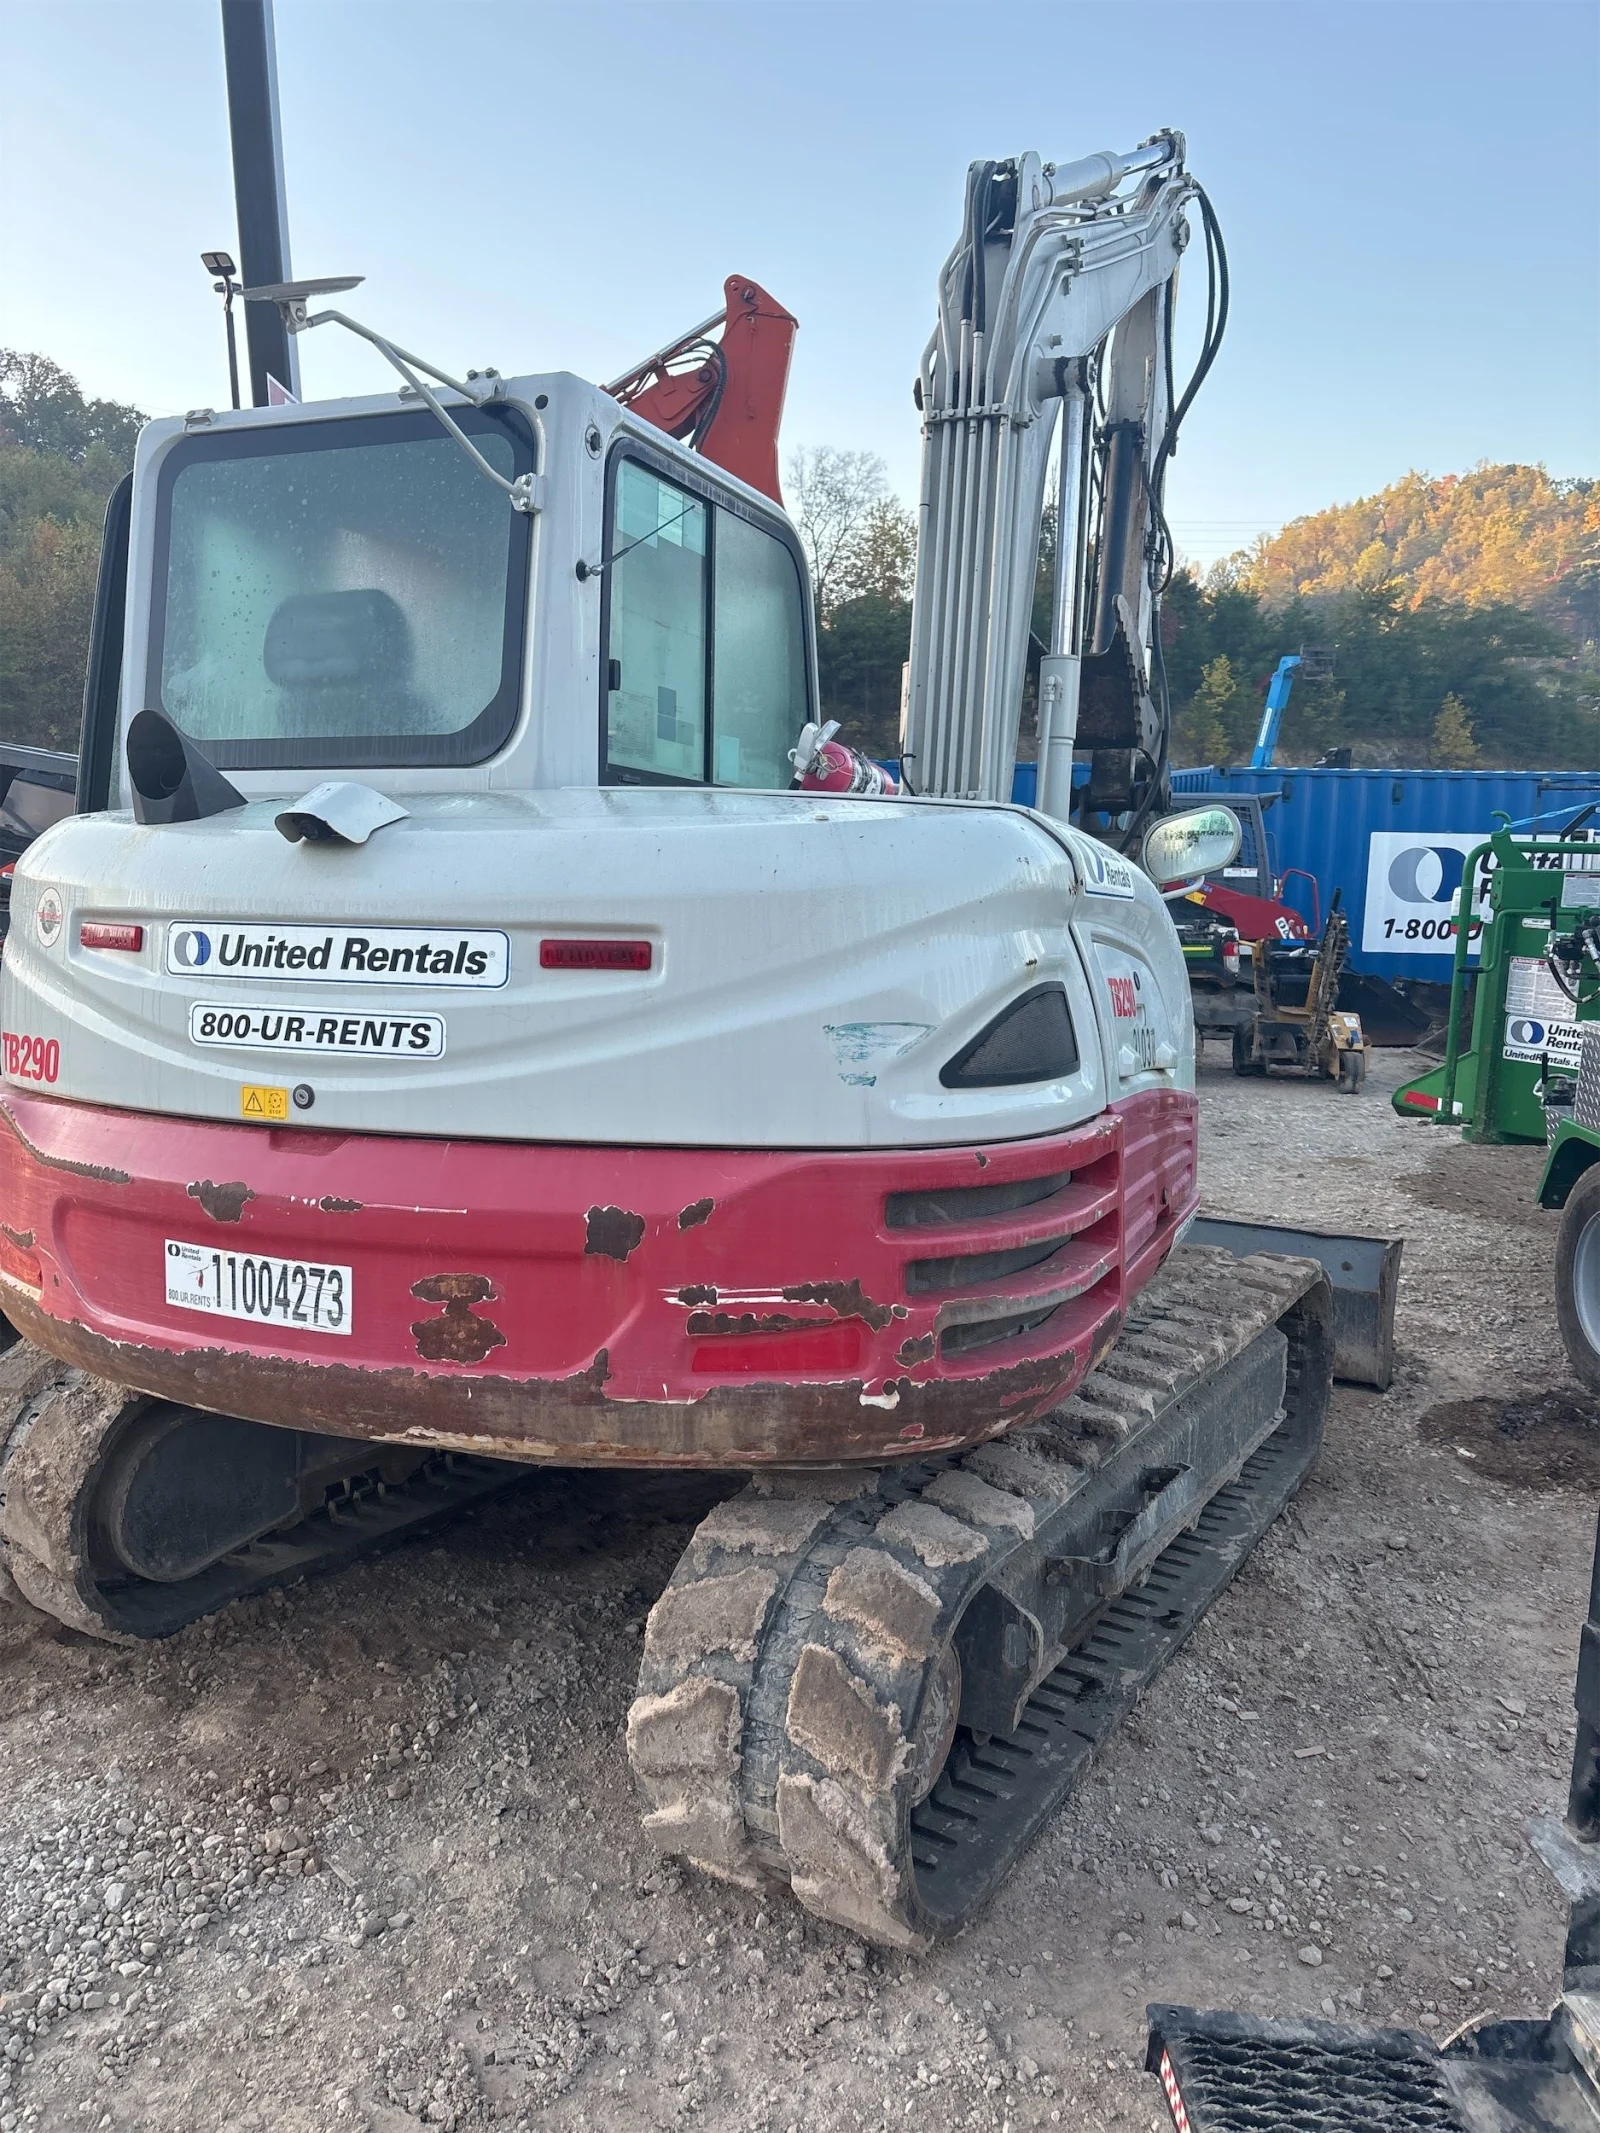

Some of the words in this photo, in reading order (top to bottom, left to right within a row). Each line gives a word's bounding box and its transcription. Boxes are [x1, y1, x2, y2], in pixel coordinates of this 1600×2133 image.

[1104, 861, 1131, 889] Rentals
[219, 934, 333, 968] United
[341, 938, 488, 975] Rentals
[1107, 977, 1137, 1017] TB290
[200, 1012, 432, 1049] 800-UR-RENTS
[1546, 1036, 1582, 1051] Rent
[1547, 1024, 1584, 1039] Unite
[3, 1032, 60, 1083] TB290
[181, 1245, 200, 1255] United
[181, 1252, 202, 1261] Rentals
[212, 1253, 344, 1327] 11004273
